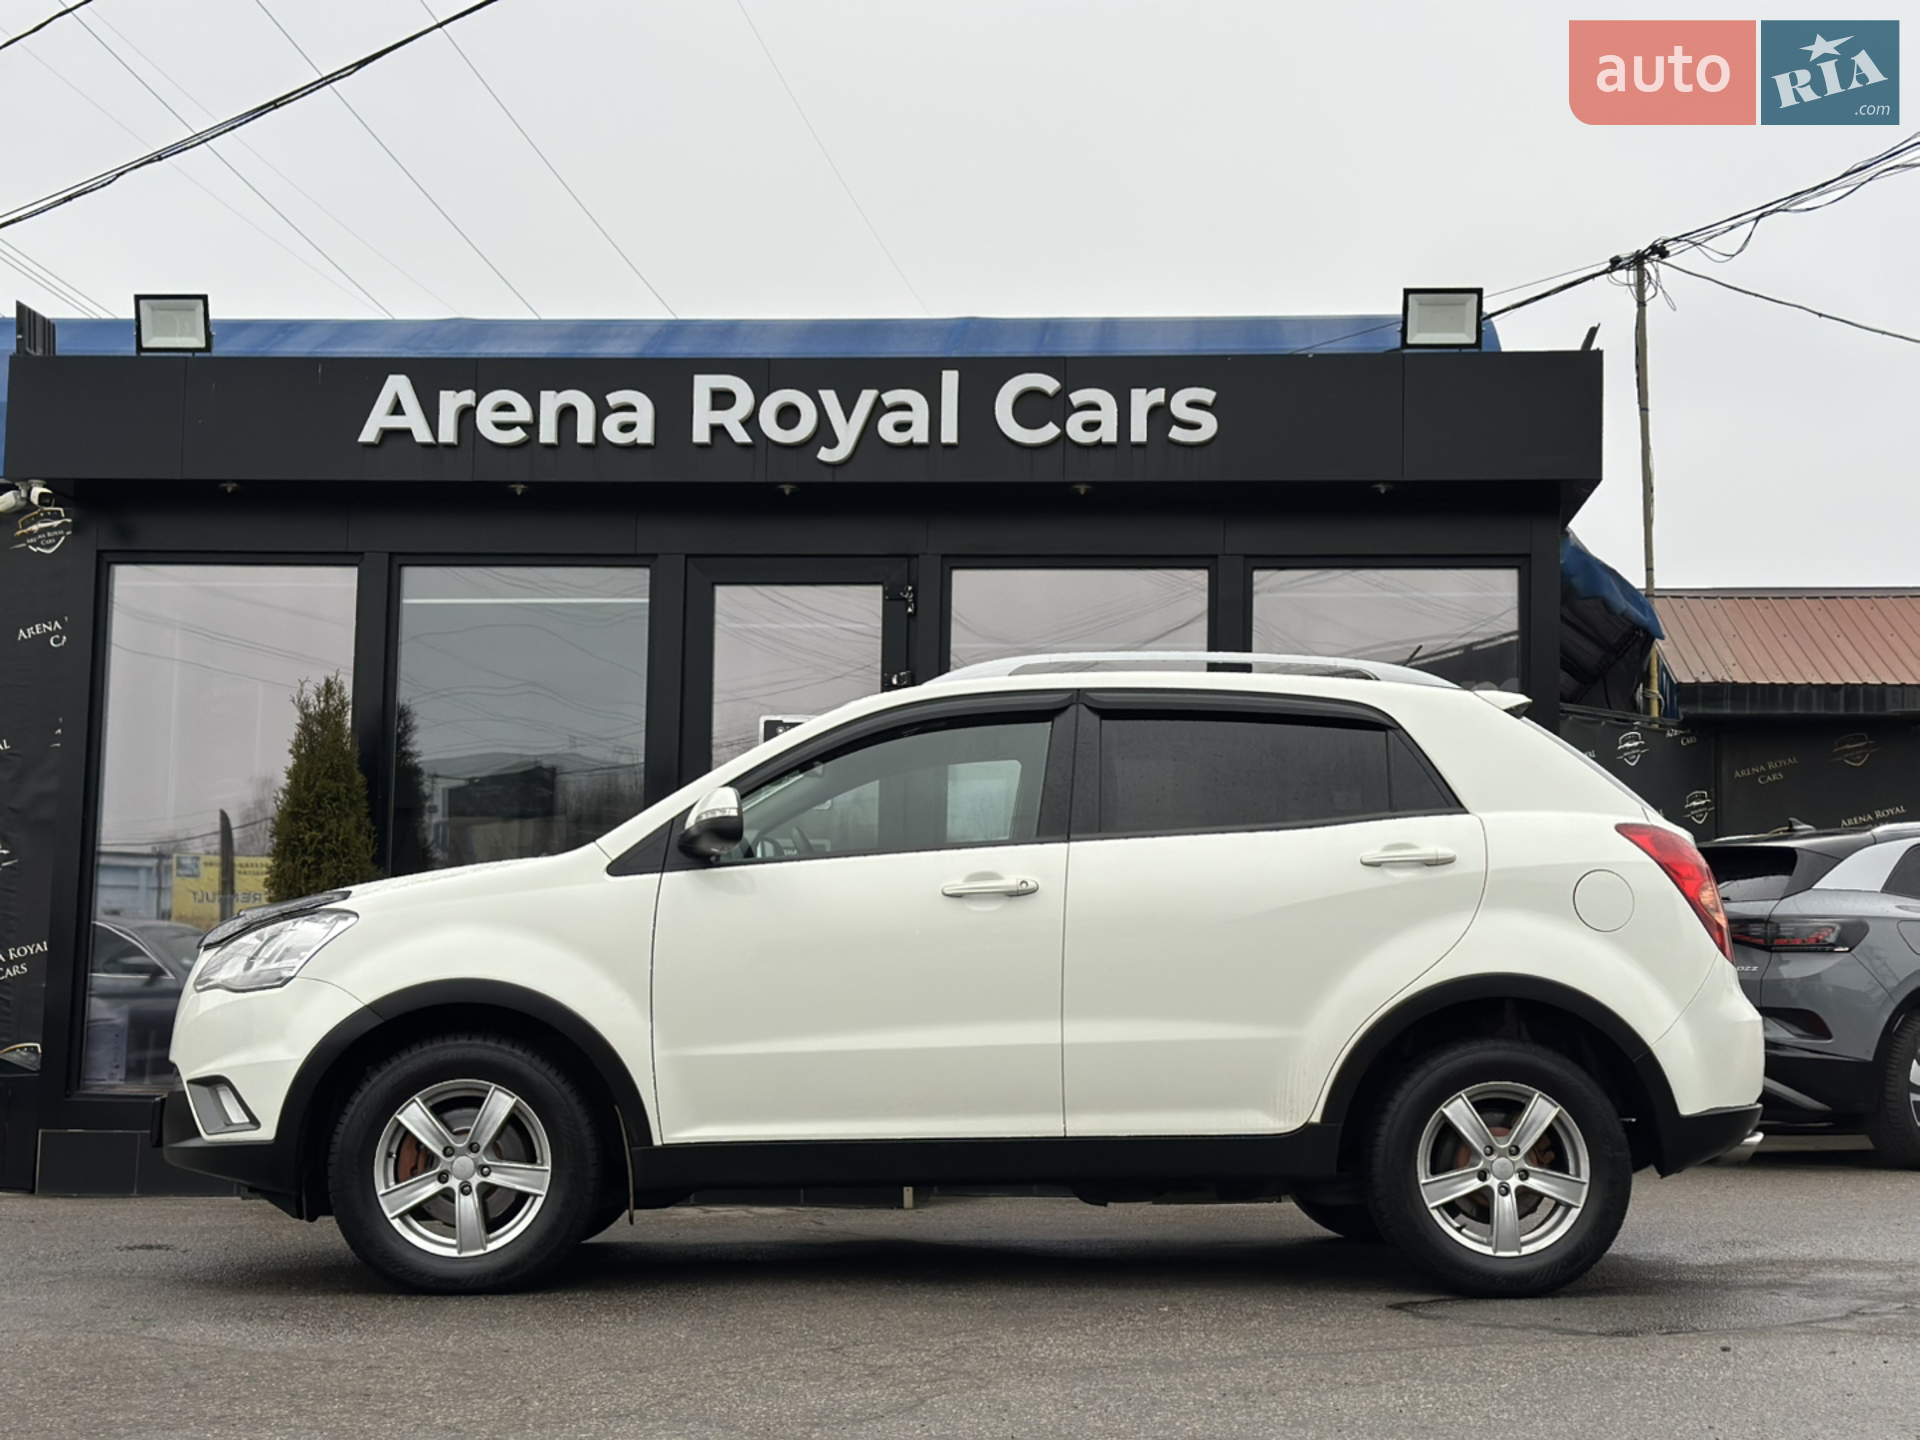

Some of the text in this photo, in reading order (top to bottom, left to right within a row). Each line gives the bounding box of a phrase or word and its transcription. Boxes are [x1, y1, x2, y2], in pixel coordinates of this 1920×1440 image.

[357, 370, 1219, 466] Arena Royal Cars
[17, 620, 62, 641] ARENA
[1734, 756, 1799, 779] ARENA ROYAL
[1757, 772, 1784, 785] CARS
[1840, 804, 1908, 828] ARENA ROYAL
